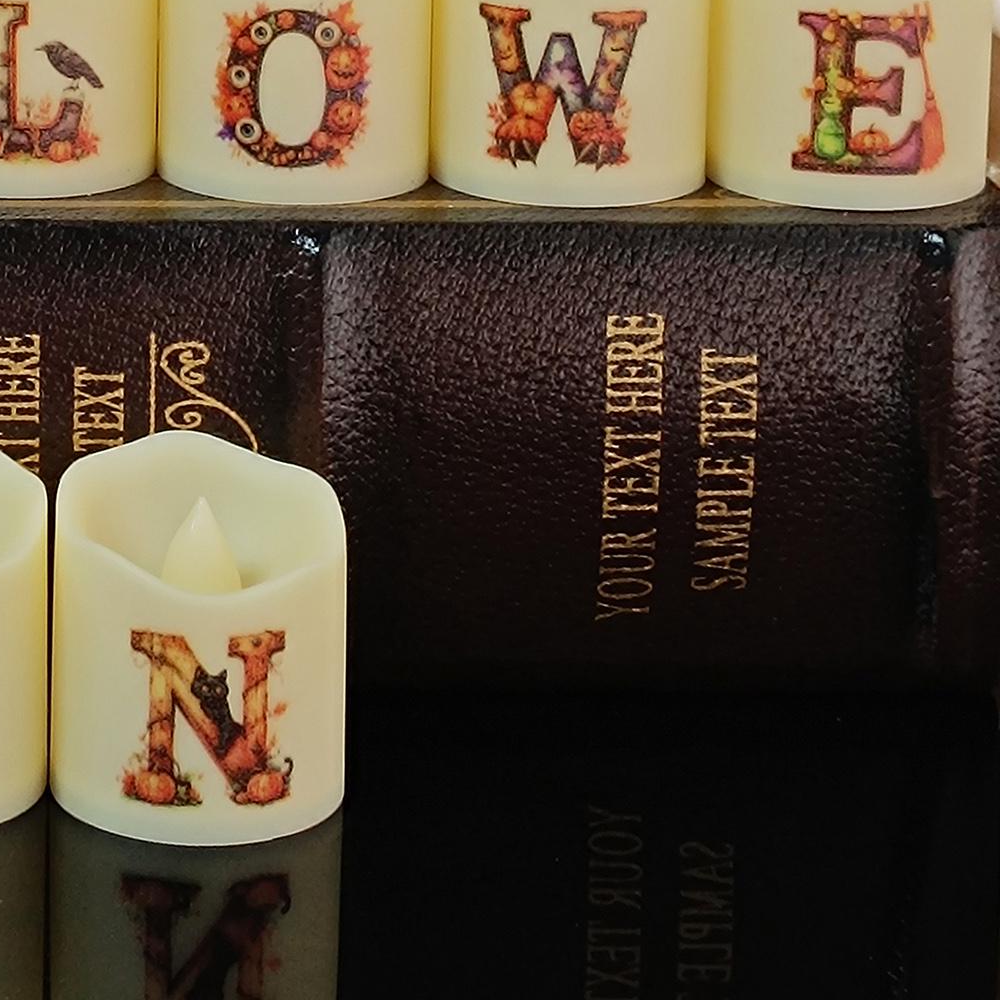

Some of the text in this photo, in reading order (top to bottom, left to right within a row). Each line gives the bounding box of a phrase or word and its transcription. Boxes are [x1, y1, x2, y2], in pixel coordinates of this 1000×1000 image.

[73, 367, 124, 452] TEXT
[595, 313, 665, 621] YOUR TEXT HERE
[691, 348, 758, 590] SAMPLE TEXT
